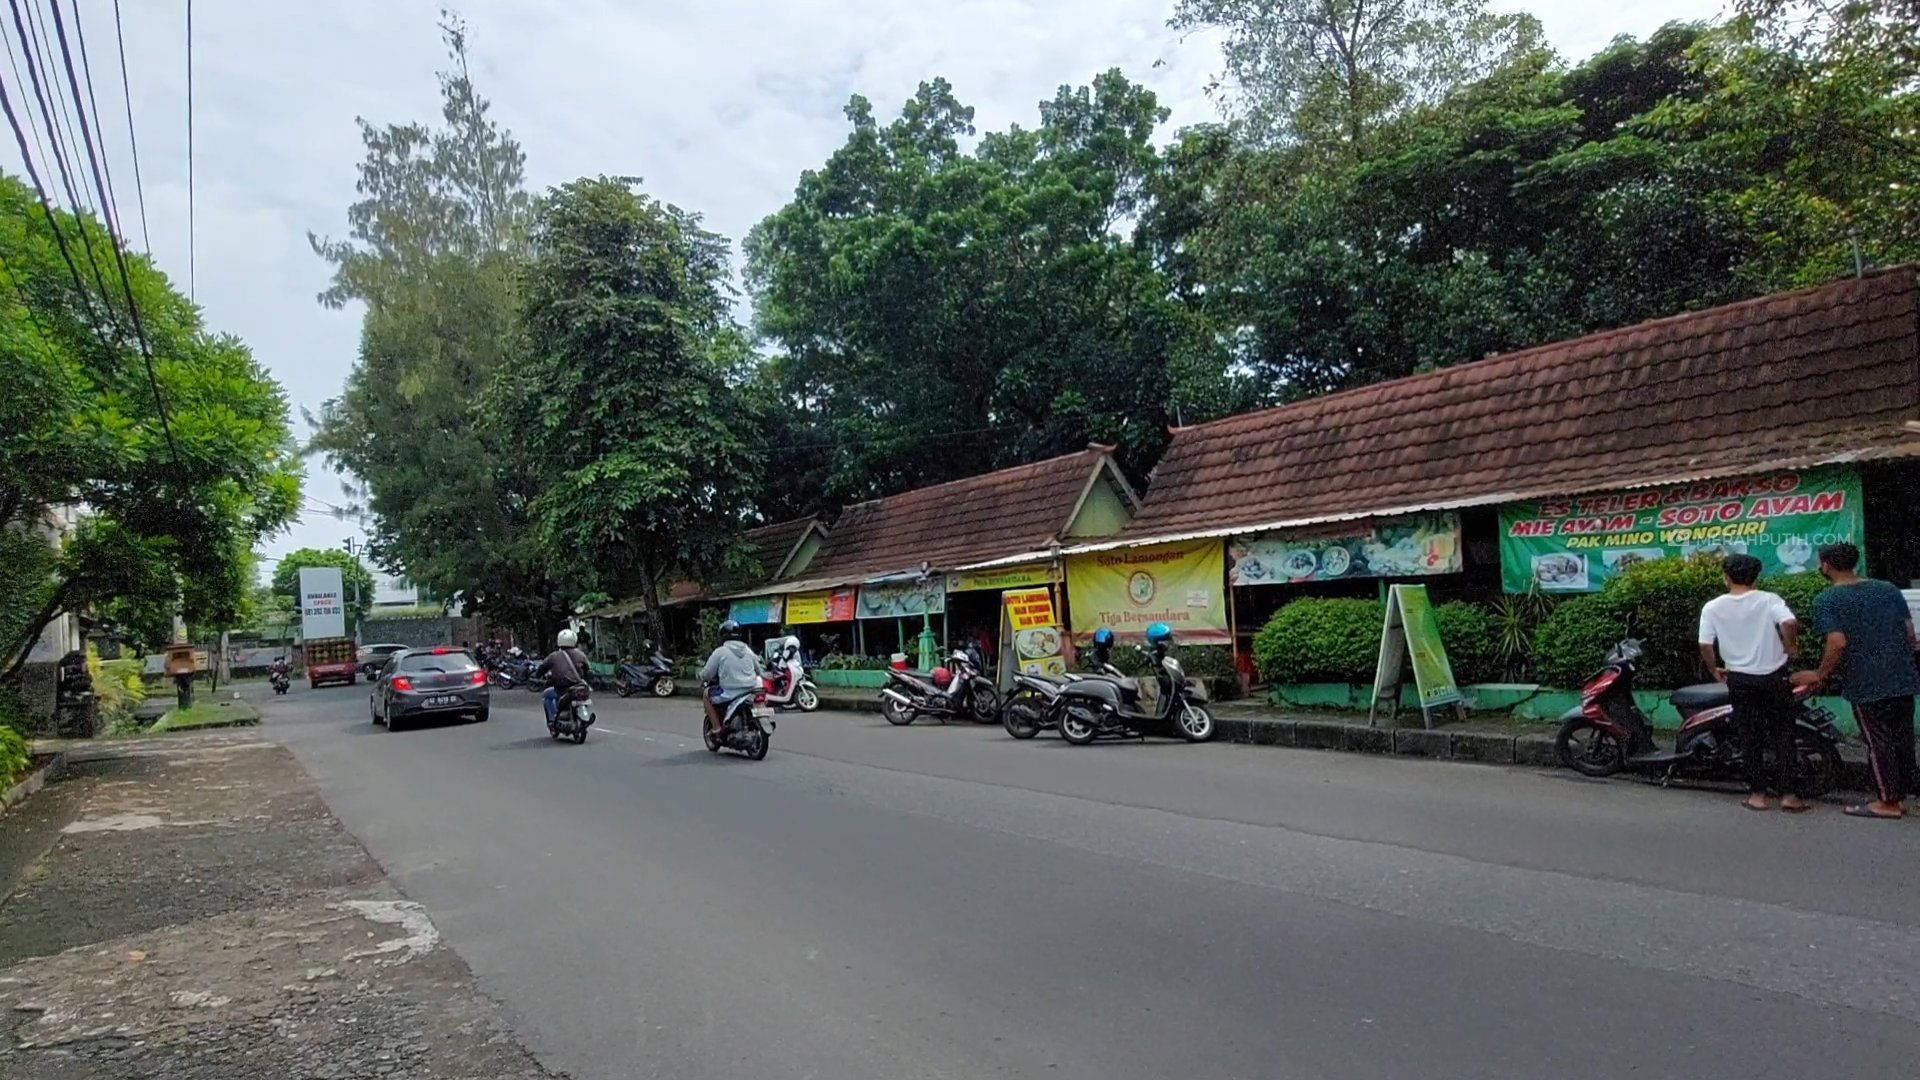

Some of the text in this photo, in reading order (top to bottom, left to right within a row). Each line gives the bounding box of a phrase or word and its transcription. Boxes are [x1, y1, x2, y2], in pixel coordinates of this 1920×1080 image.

[1540, 502, 1569, 517] ES
[1576, 492, 1660, 516] TELER
[1687, 472, 1799, 503] BAKSO
[1509, 519, 1557, 538] MIE
[1558, 513, 1635, 536] AYAM
[1655, 500, 1743, 528] SOTO
[1747, 490, 1846, 519] AYAM
[1566, 521, 1768, 549] PAK MINO WONOGIRI
[1096, 550, 1184, 567] Soto Lamongan
[1099, 608, 1190, 626] Tiga Bersaudara
